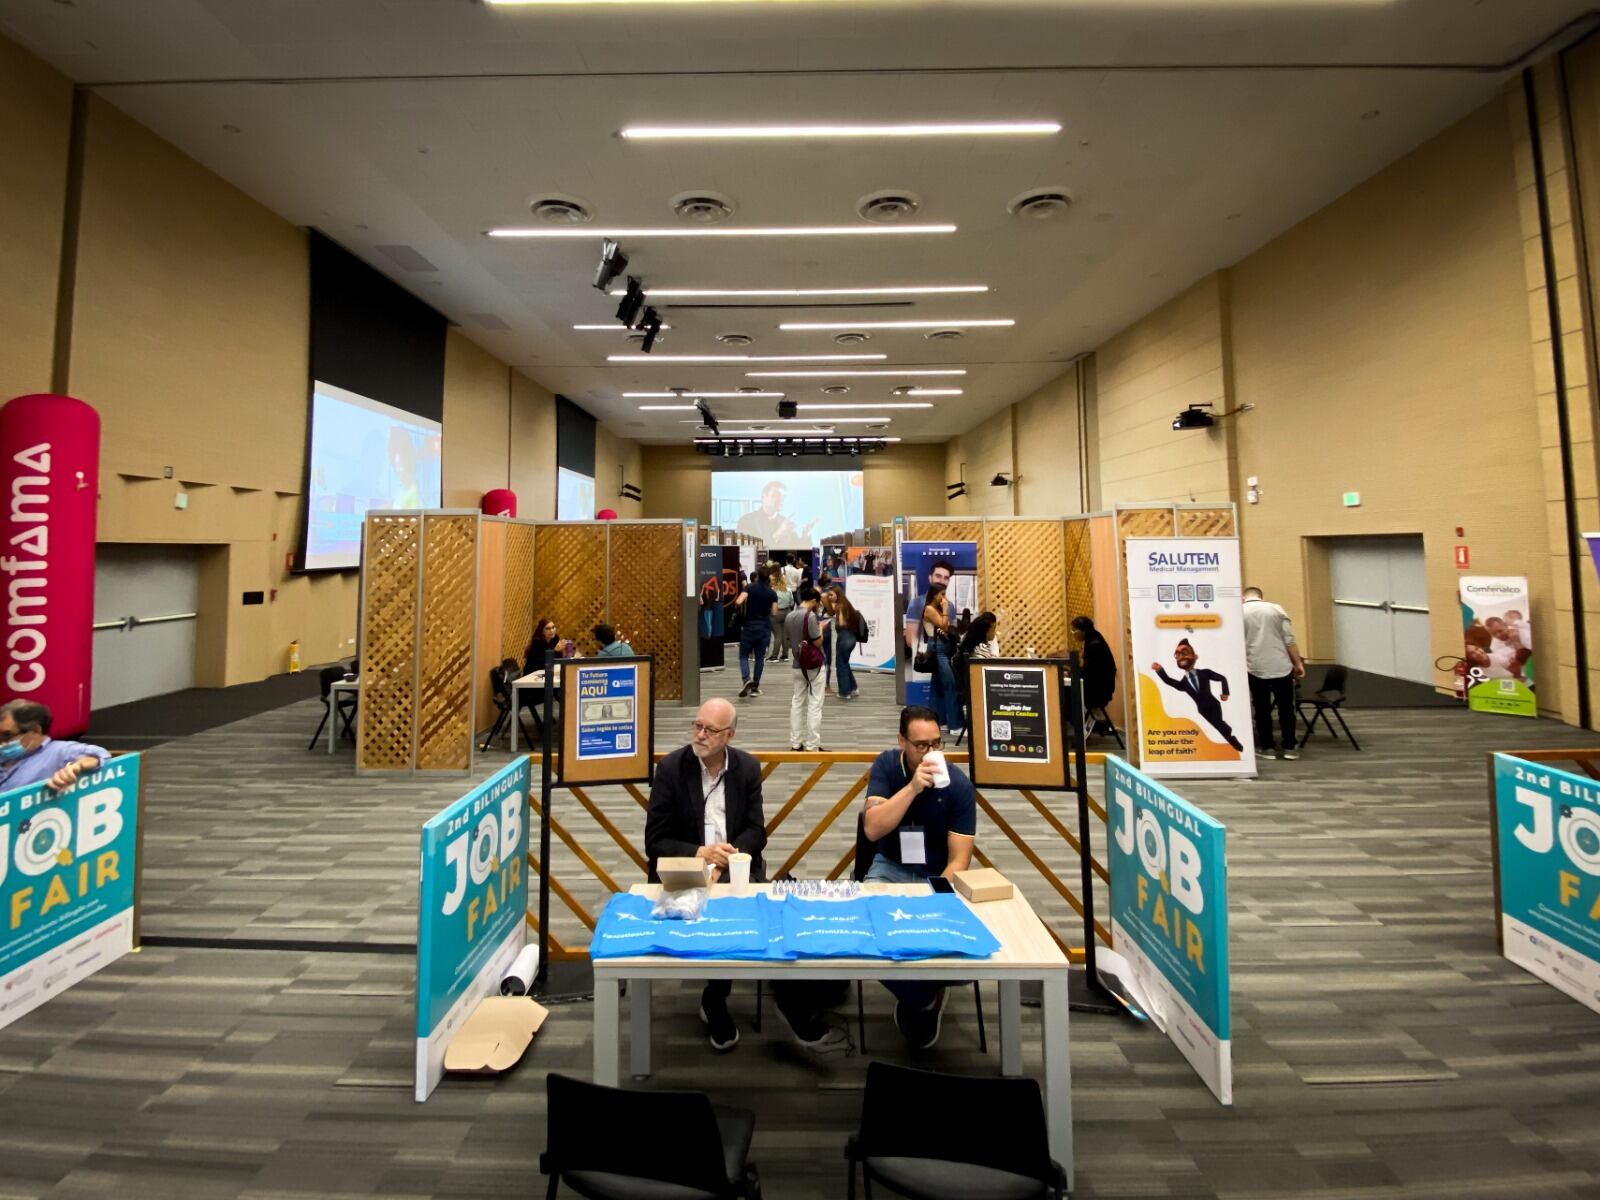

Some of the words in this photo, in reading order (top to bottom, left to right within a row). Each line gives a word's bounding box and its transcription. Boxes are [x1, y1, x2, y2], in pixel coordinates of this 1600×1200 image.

[1148, 552, 1219, 566] SALUTEM
[1466, 585, 1521, 594] Comfenalco
[1148, 748, 1165, 756] leap
[1514, 766, 1550, 788] 2nd
[446, 808, 469, 837] 2nd
[473, 768, 524, 815] BILINGUAL
[1114, 767, 1132, 788] 2nd
[1135, 781, 1202, 838] BILINGUAL
[441, 790, 523, 916] JOB
[1114, 787, 1204, 915] JOB
[10, 850, 120, 930] FAIR
[466, 855, 521, 942] FAIR
[1137, 873, 1205, 975] FAIR
